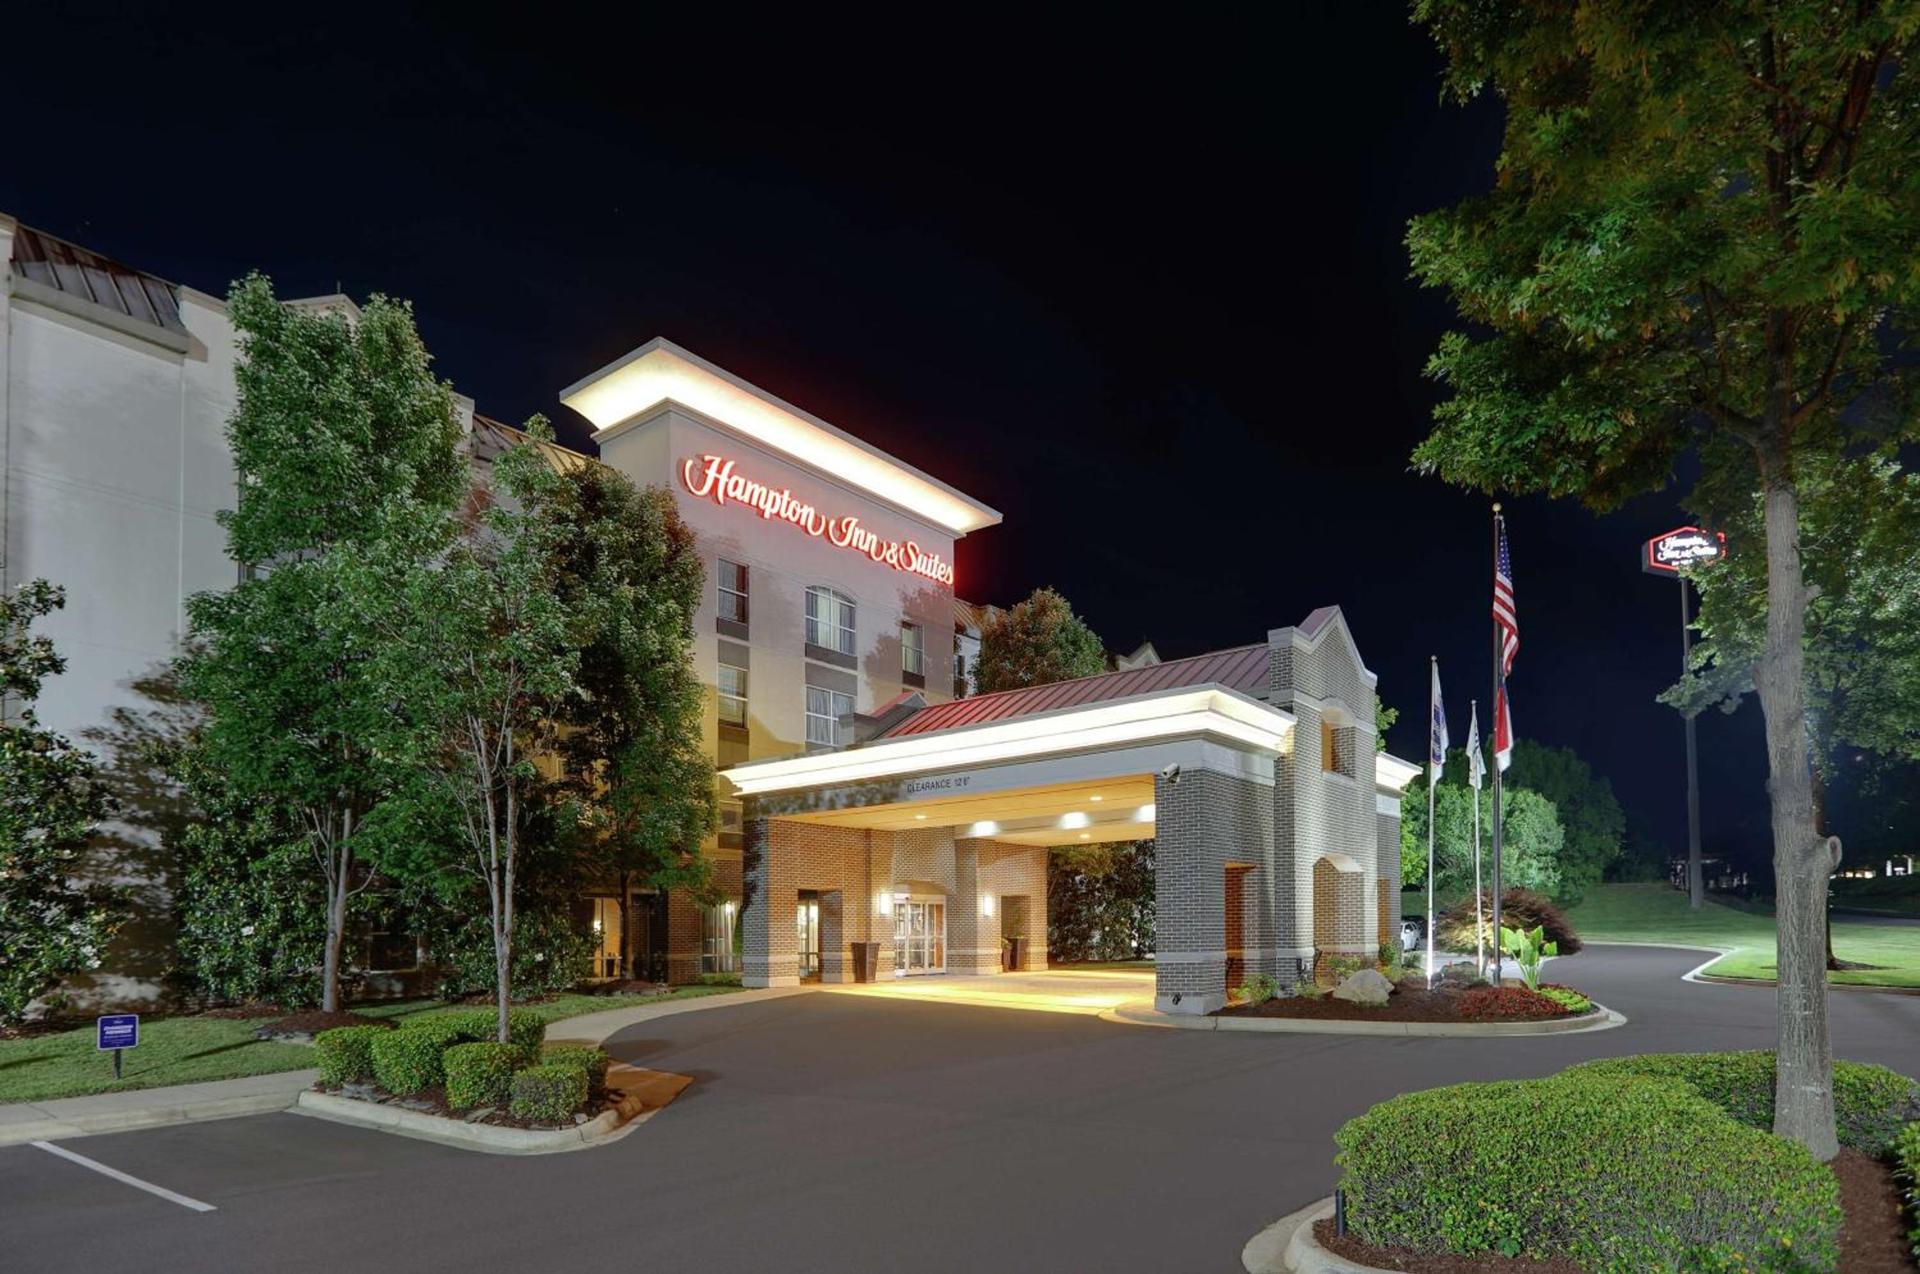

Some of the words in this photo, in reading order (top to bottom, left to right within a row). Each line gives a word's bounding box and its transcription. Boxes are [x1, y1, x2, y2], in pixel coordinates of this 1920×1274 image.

[684, 454, 826, 536] Hampton
[828, 516, 887, 562] Inn
[883, 542, 902, 571] &
[898, 540, 954, 585] Suites
[907, 778, 951, 793] CLEARANCE
